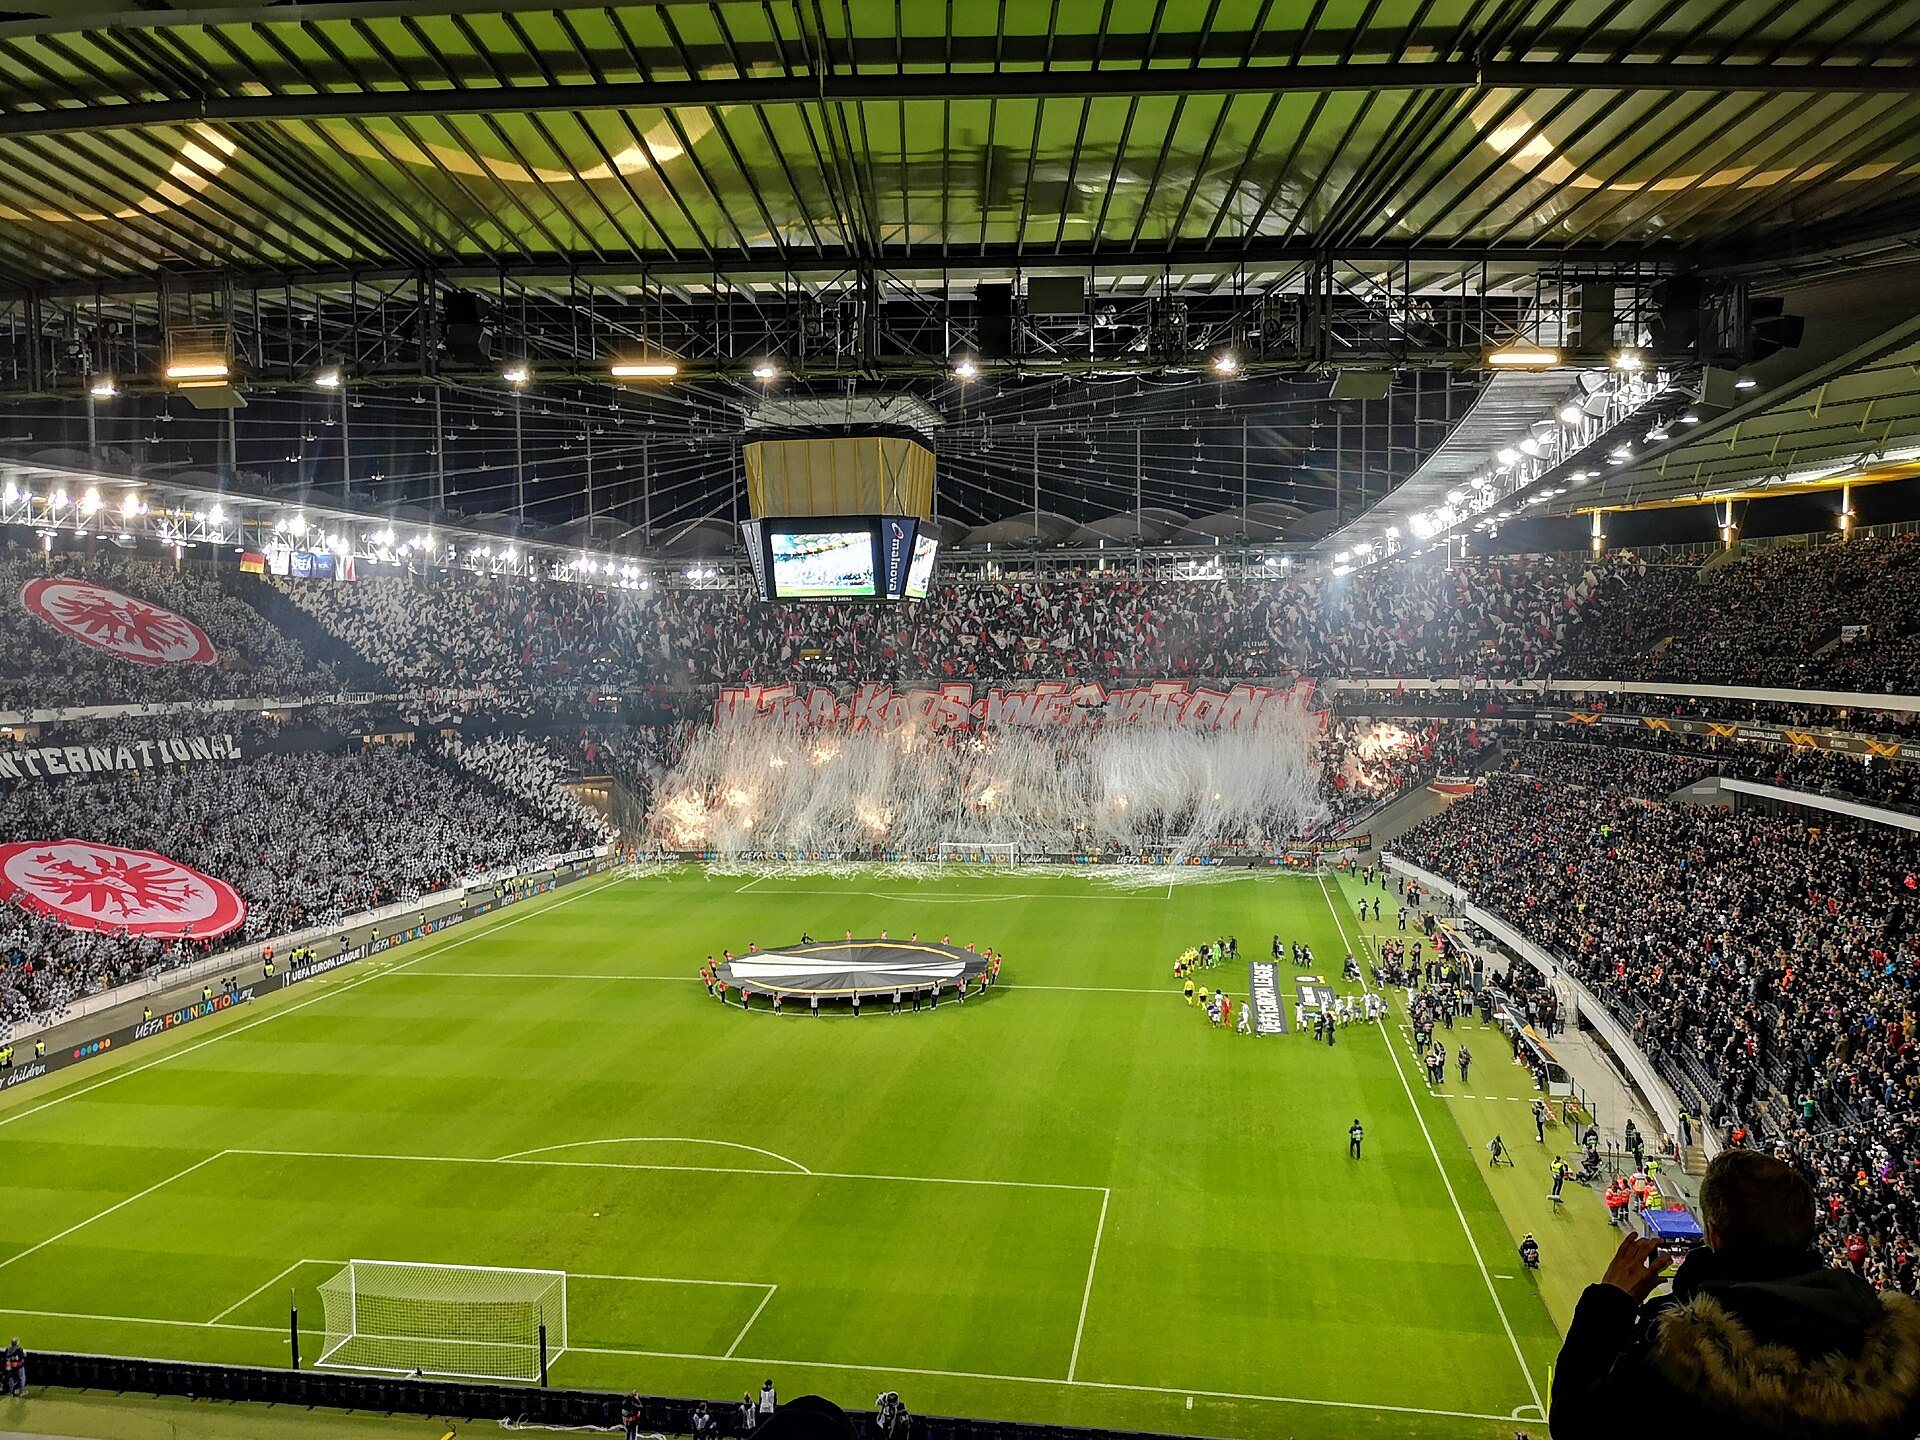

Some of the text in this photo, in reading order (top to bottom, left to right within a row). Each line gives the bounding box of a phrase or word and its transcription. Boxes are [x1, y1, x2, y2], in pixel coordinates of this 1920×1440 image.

[0, 734, 242, 779] NTERNATIONAL
[292, 948, 360, 982] UEFA EUROPA LEAGUE
[135, 1018, 164, 1040] UEFA
[7, 1062, 46, 1086] children
